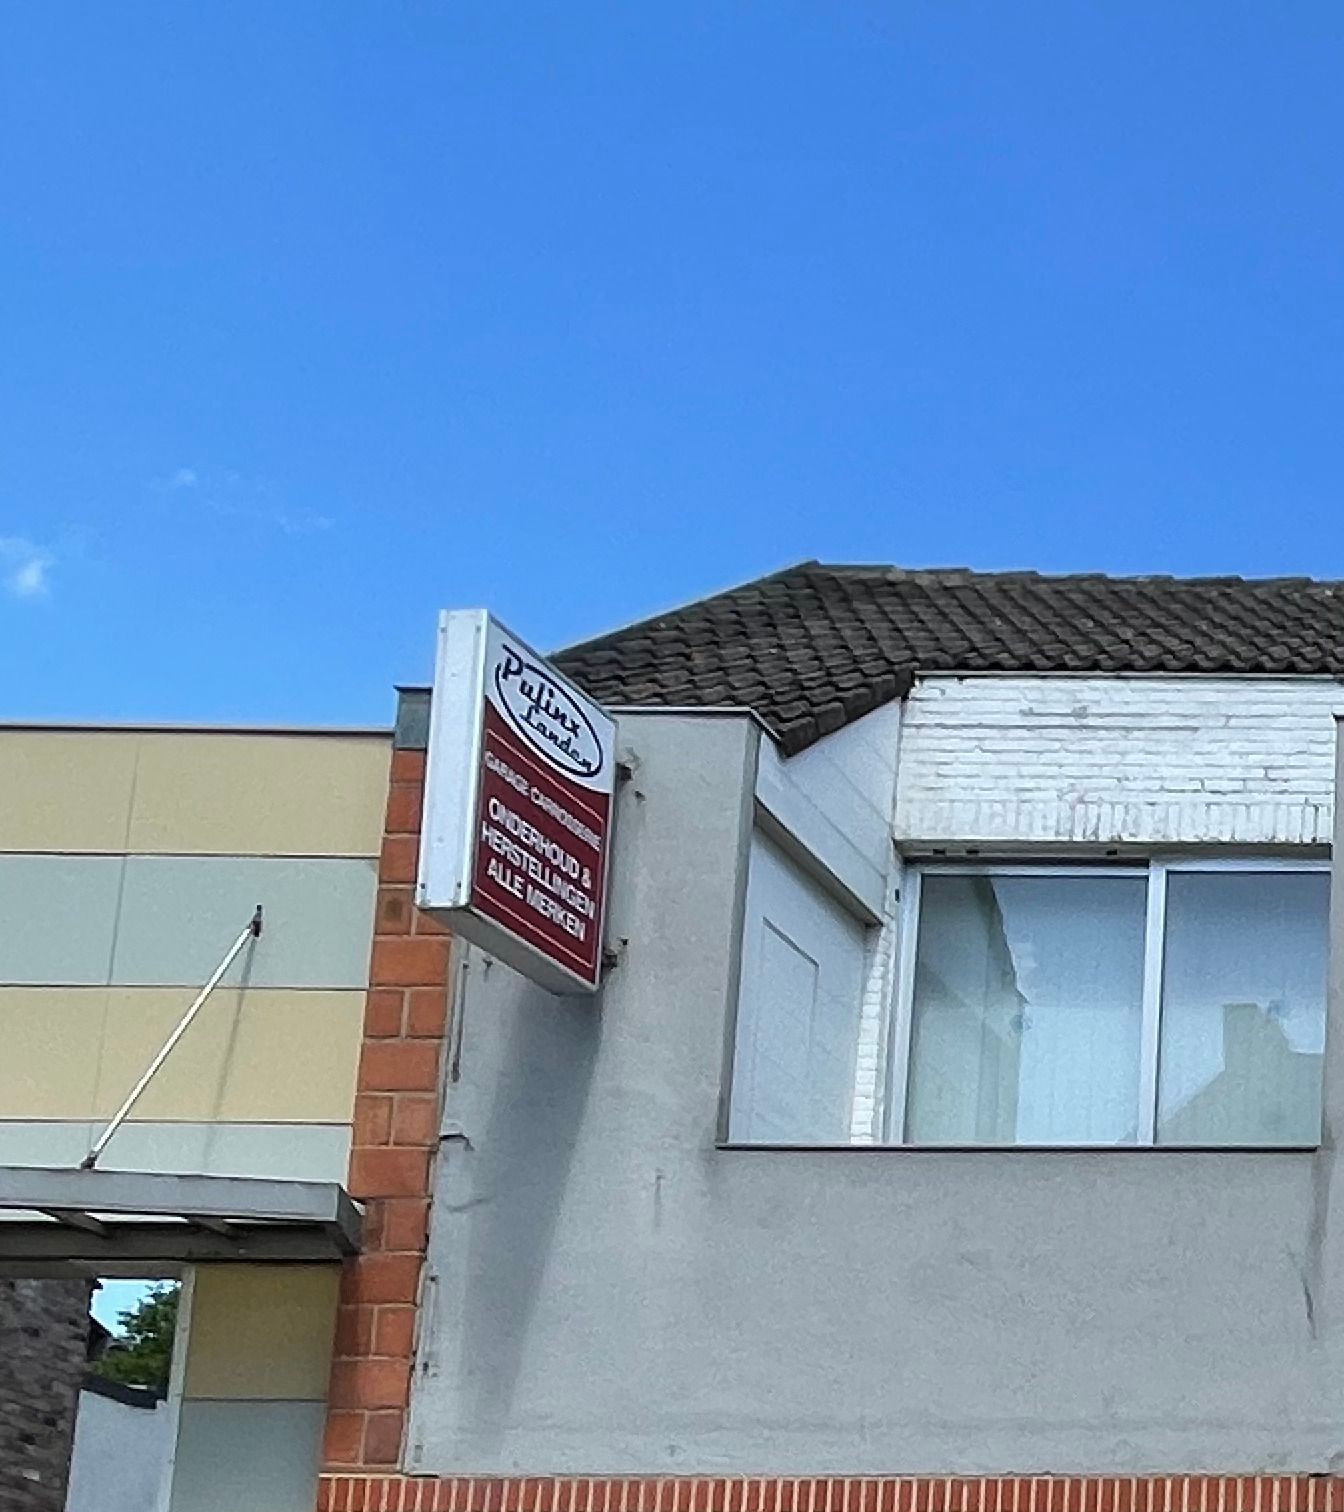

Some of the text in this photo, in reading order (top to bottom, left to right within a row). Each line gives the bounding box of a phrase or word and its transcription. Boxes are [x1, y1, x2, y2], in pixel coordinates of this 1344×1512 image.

[502, 643, 580, 738] Pulinx
[519, 705, 592, 773] Landen
[481, 820, 596, 920] HERSTELLINGEN
[488, 796, 592, 890] ONDERHOUD &
[486, 856, 586, 942] ALLE MERKEN
